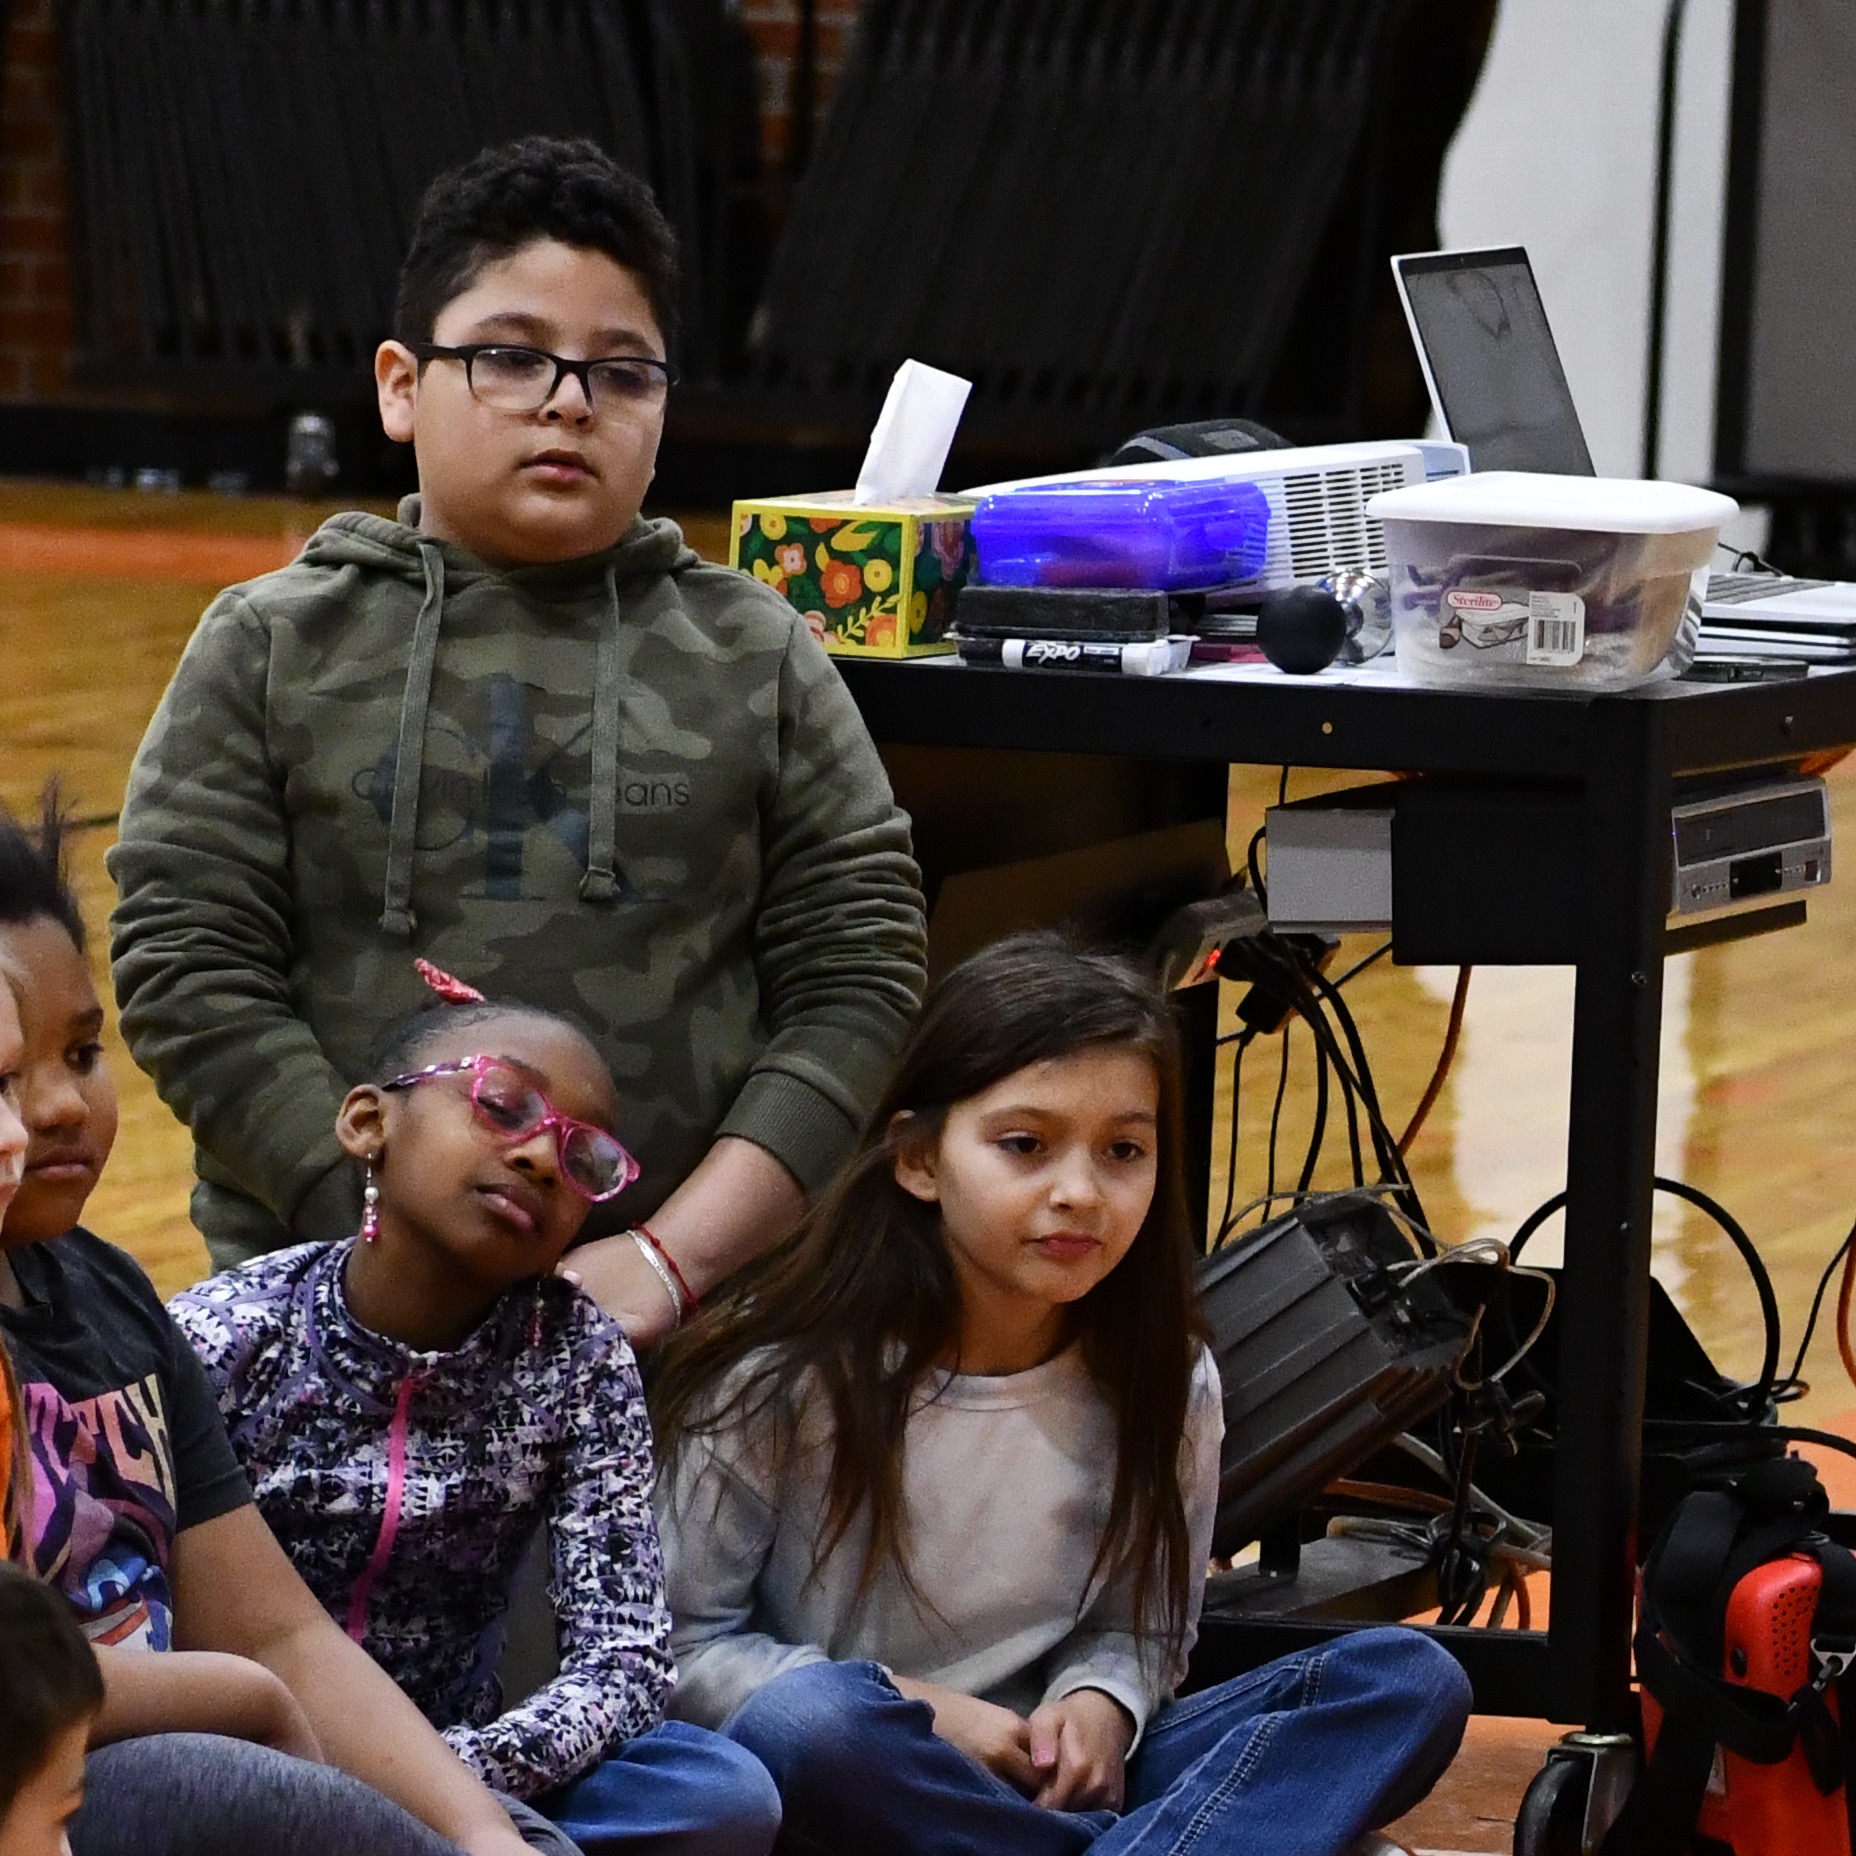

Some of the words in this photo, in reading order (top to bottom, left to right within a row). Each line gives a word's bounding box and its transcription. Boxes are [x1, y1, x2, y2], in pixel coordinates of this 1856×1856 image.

[1452, 593, 1496, 609] Sterilite
[1025, 643, 1081, 665] EXPO
[616, 782, 690, 807] ans
